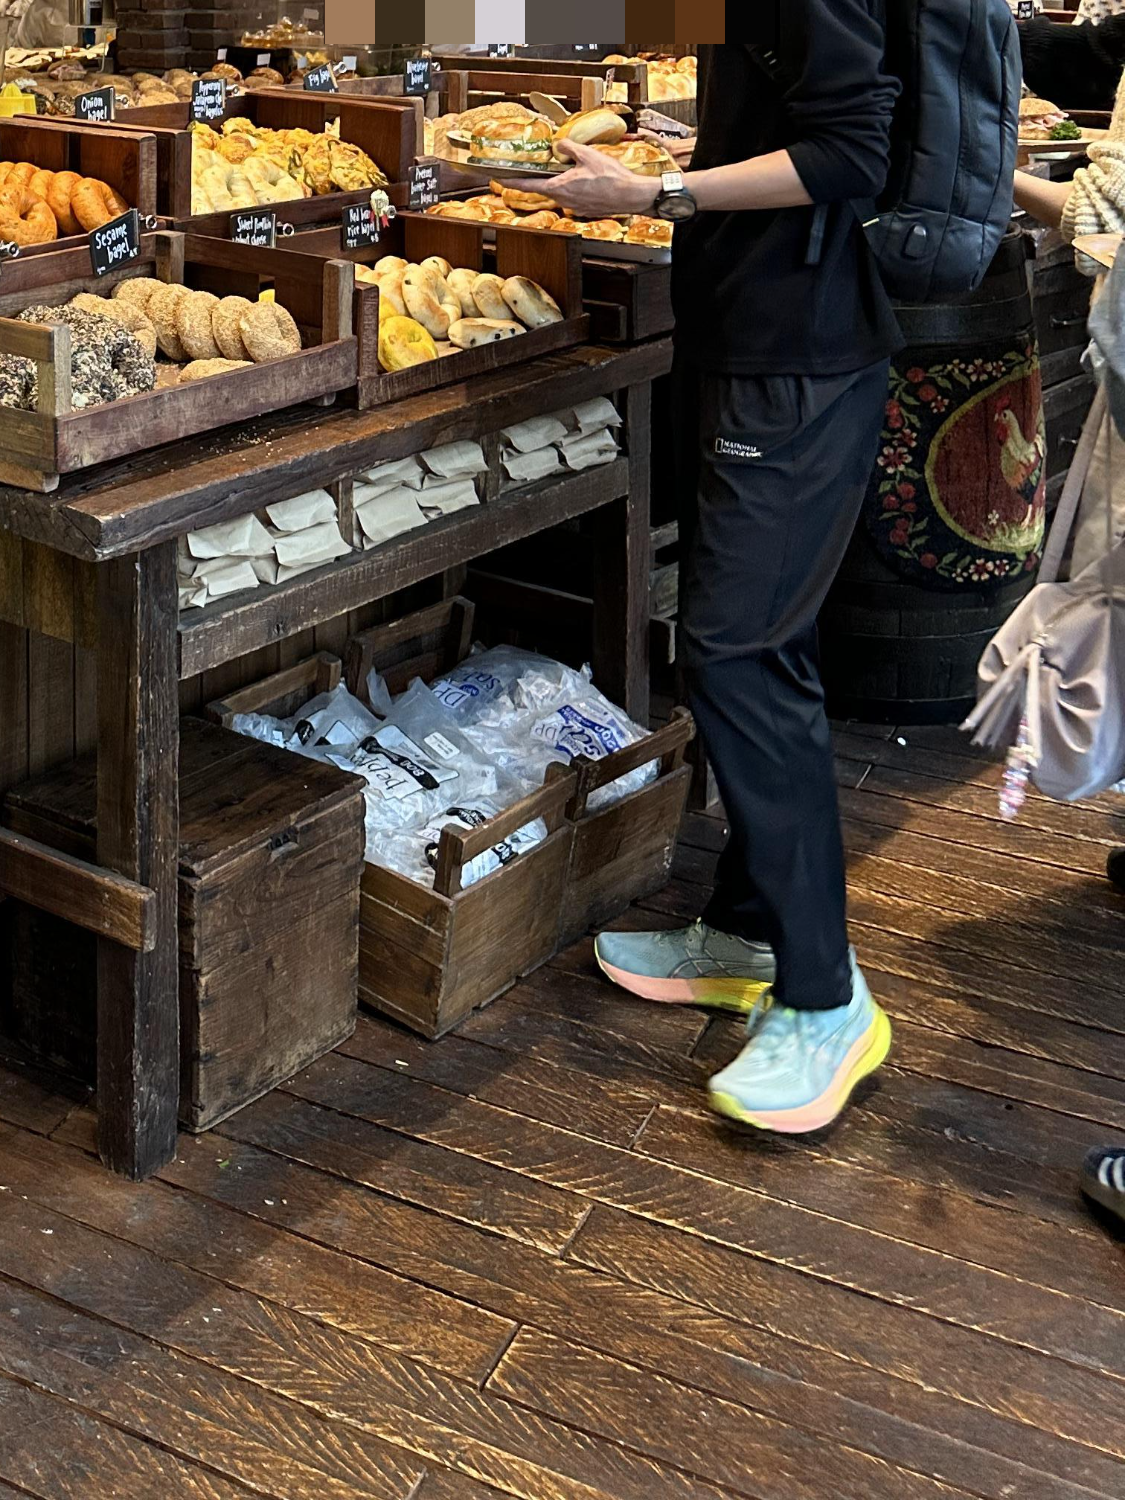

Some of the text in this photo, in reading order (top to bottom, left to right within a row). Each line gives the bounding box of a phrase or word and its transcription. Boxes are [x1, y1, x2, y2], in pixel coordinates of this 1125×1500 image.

[81, 97, 103, 112] Onion
[96, 223, 127, 249] Sesame
[107, 237, 129, 264] bagel
